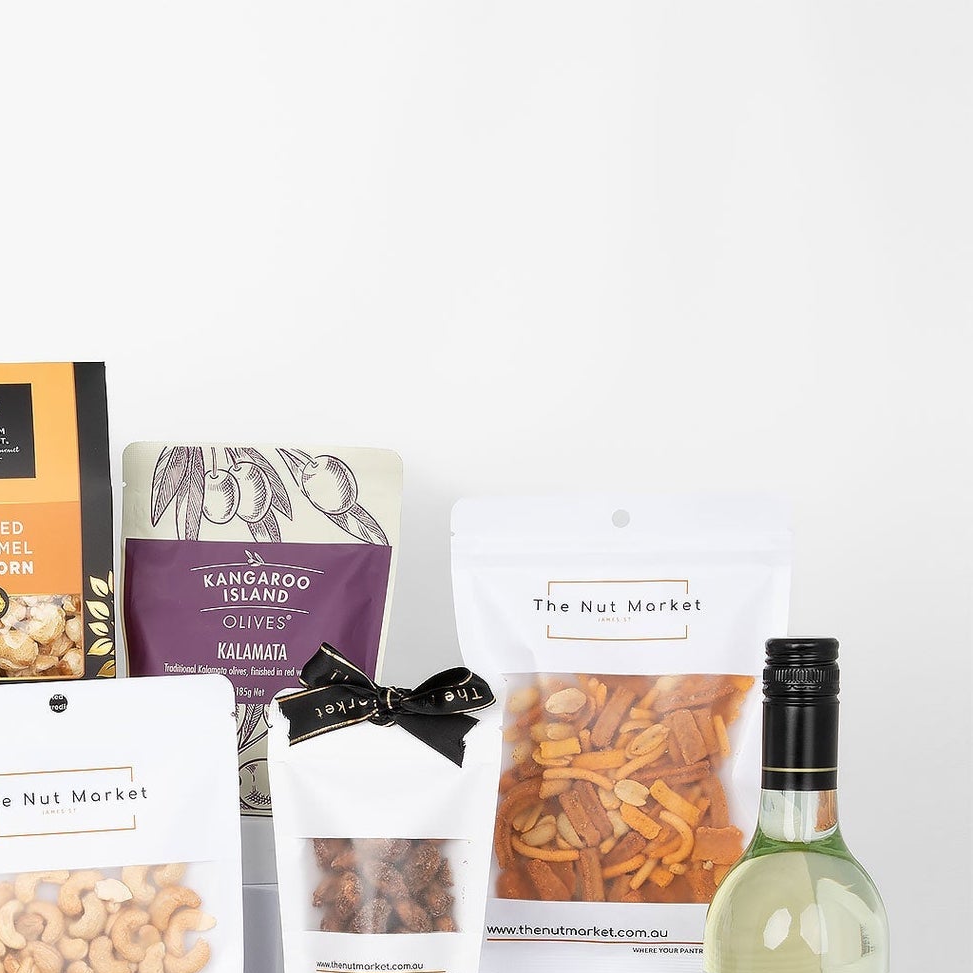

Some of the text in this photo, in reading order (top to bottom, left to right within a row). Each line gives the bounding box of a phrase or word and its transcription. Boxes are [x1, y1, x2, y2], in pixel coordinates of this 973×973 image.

[203, 570, 311, 590] KANGAROO
[223, 587, 289, 603] ISLAND
[533, 598, 702, 613] The Nut Market
[217, 641, 288, 661] KALAMATA
[164, 662, 197, 673] Traditional
[197, 664, 227, 674] Kalamata
[228, 665, 249, 677] olives,
[250, 666, 276, 676] finished
[276, 667, 283, 676] in
[284, 667, 295, 677] red
[236, 686, 265, 698] 185g Net
[23, 792, 61, 807] Nut
[72, 787, 148, 803] Market
[487, 924, 668, 938] www.thenutmarket.com.au
[316, 960, 424, 971] www.thenutmarket.com.au
